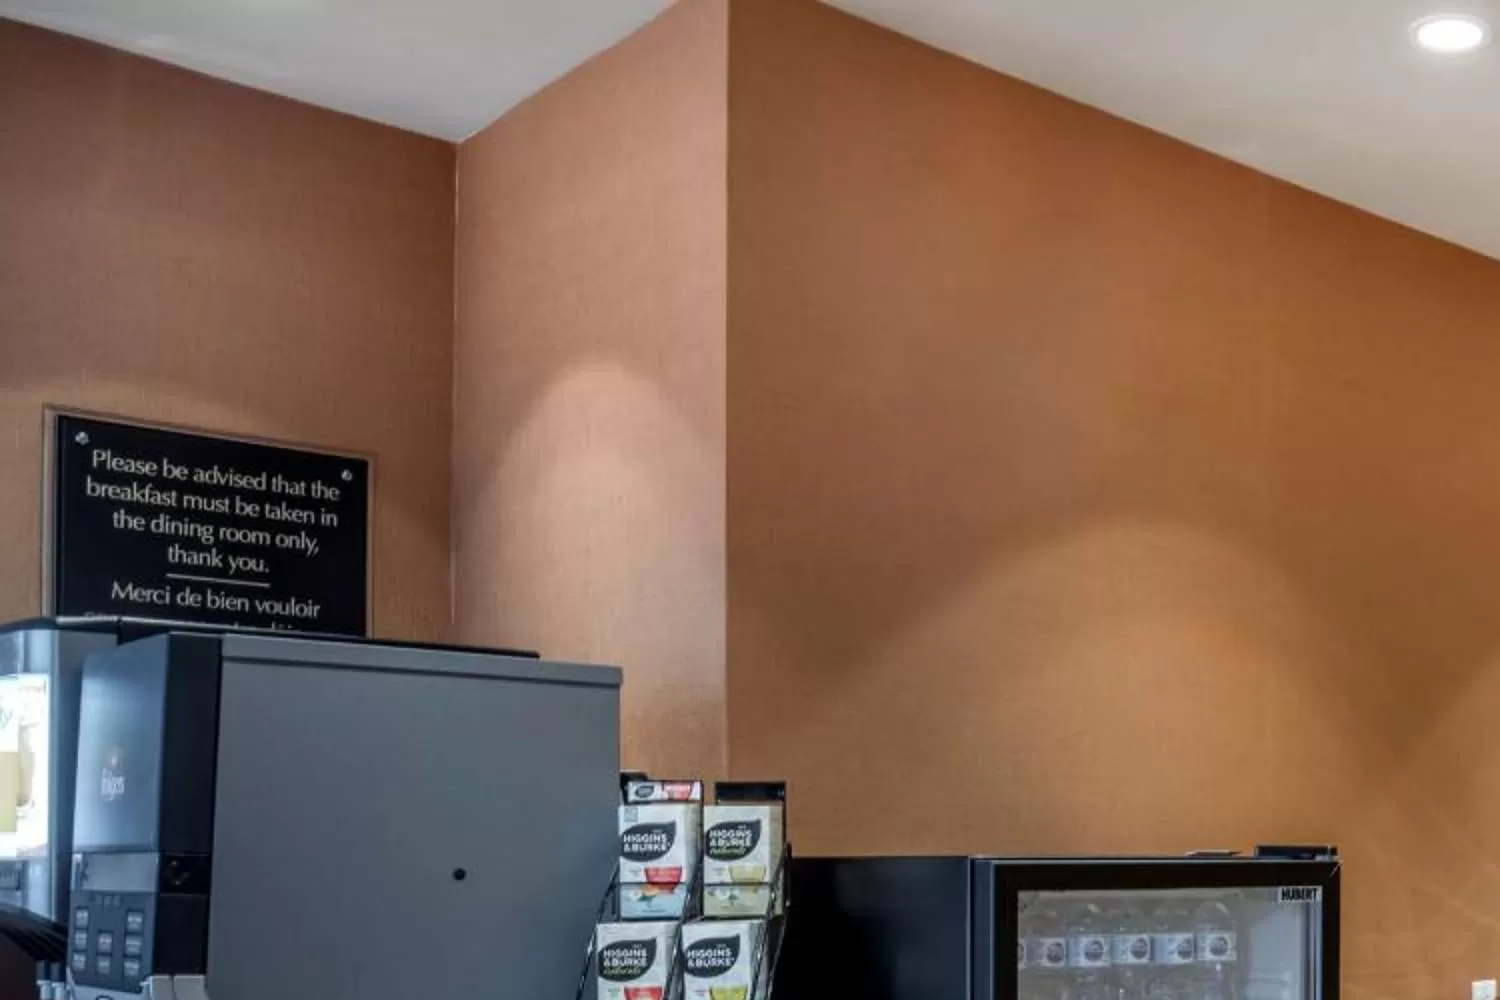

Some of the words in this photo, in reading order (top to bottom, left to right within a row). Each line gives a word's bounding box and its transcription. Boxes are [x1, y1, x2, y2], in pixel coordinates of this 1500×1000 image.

[92, 449, 157, 477] Please
[163, 458, 188, 480] be
[193, 465, 267, 492] advised
[271, 474, 306, 497] that
[311, 479, 341, 501] the
[86, 475, 177, 507] breakfast
[183, 493, 230, 513] must
[235, 496, 260, 518] be
[265, 501, 315, 524] taken
[321, 507, 338, 527] in
[112, 509, 145, 531] the
[151, 513, 215, 544] dining
[220, 527, 271, 545] room
[275, 531, 320, 557] only,
[168, 544, 222, 568] thank
[228, 554, 269, 575] you.
[111, 581, 170, 604] Merci
[176, 586, 202, 607] de
[207, 588, 249, 612] bien
[255, 597, 321, 618] vouloir
[623, 833, 668, 844] HIGGINS
[709, 829, 752, 839] HIGGINS
[1281, 888, 1318, 901] HUBERT
[603, 948, 647, 958] HIGGINS
[687, 948, 732, 958] HIGGINS
